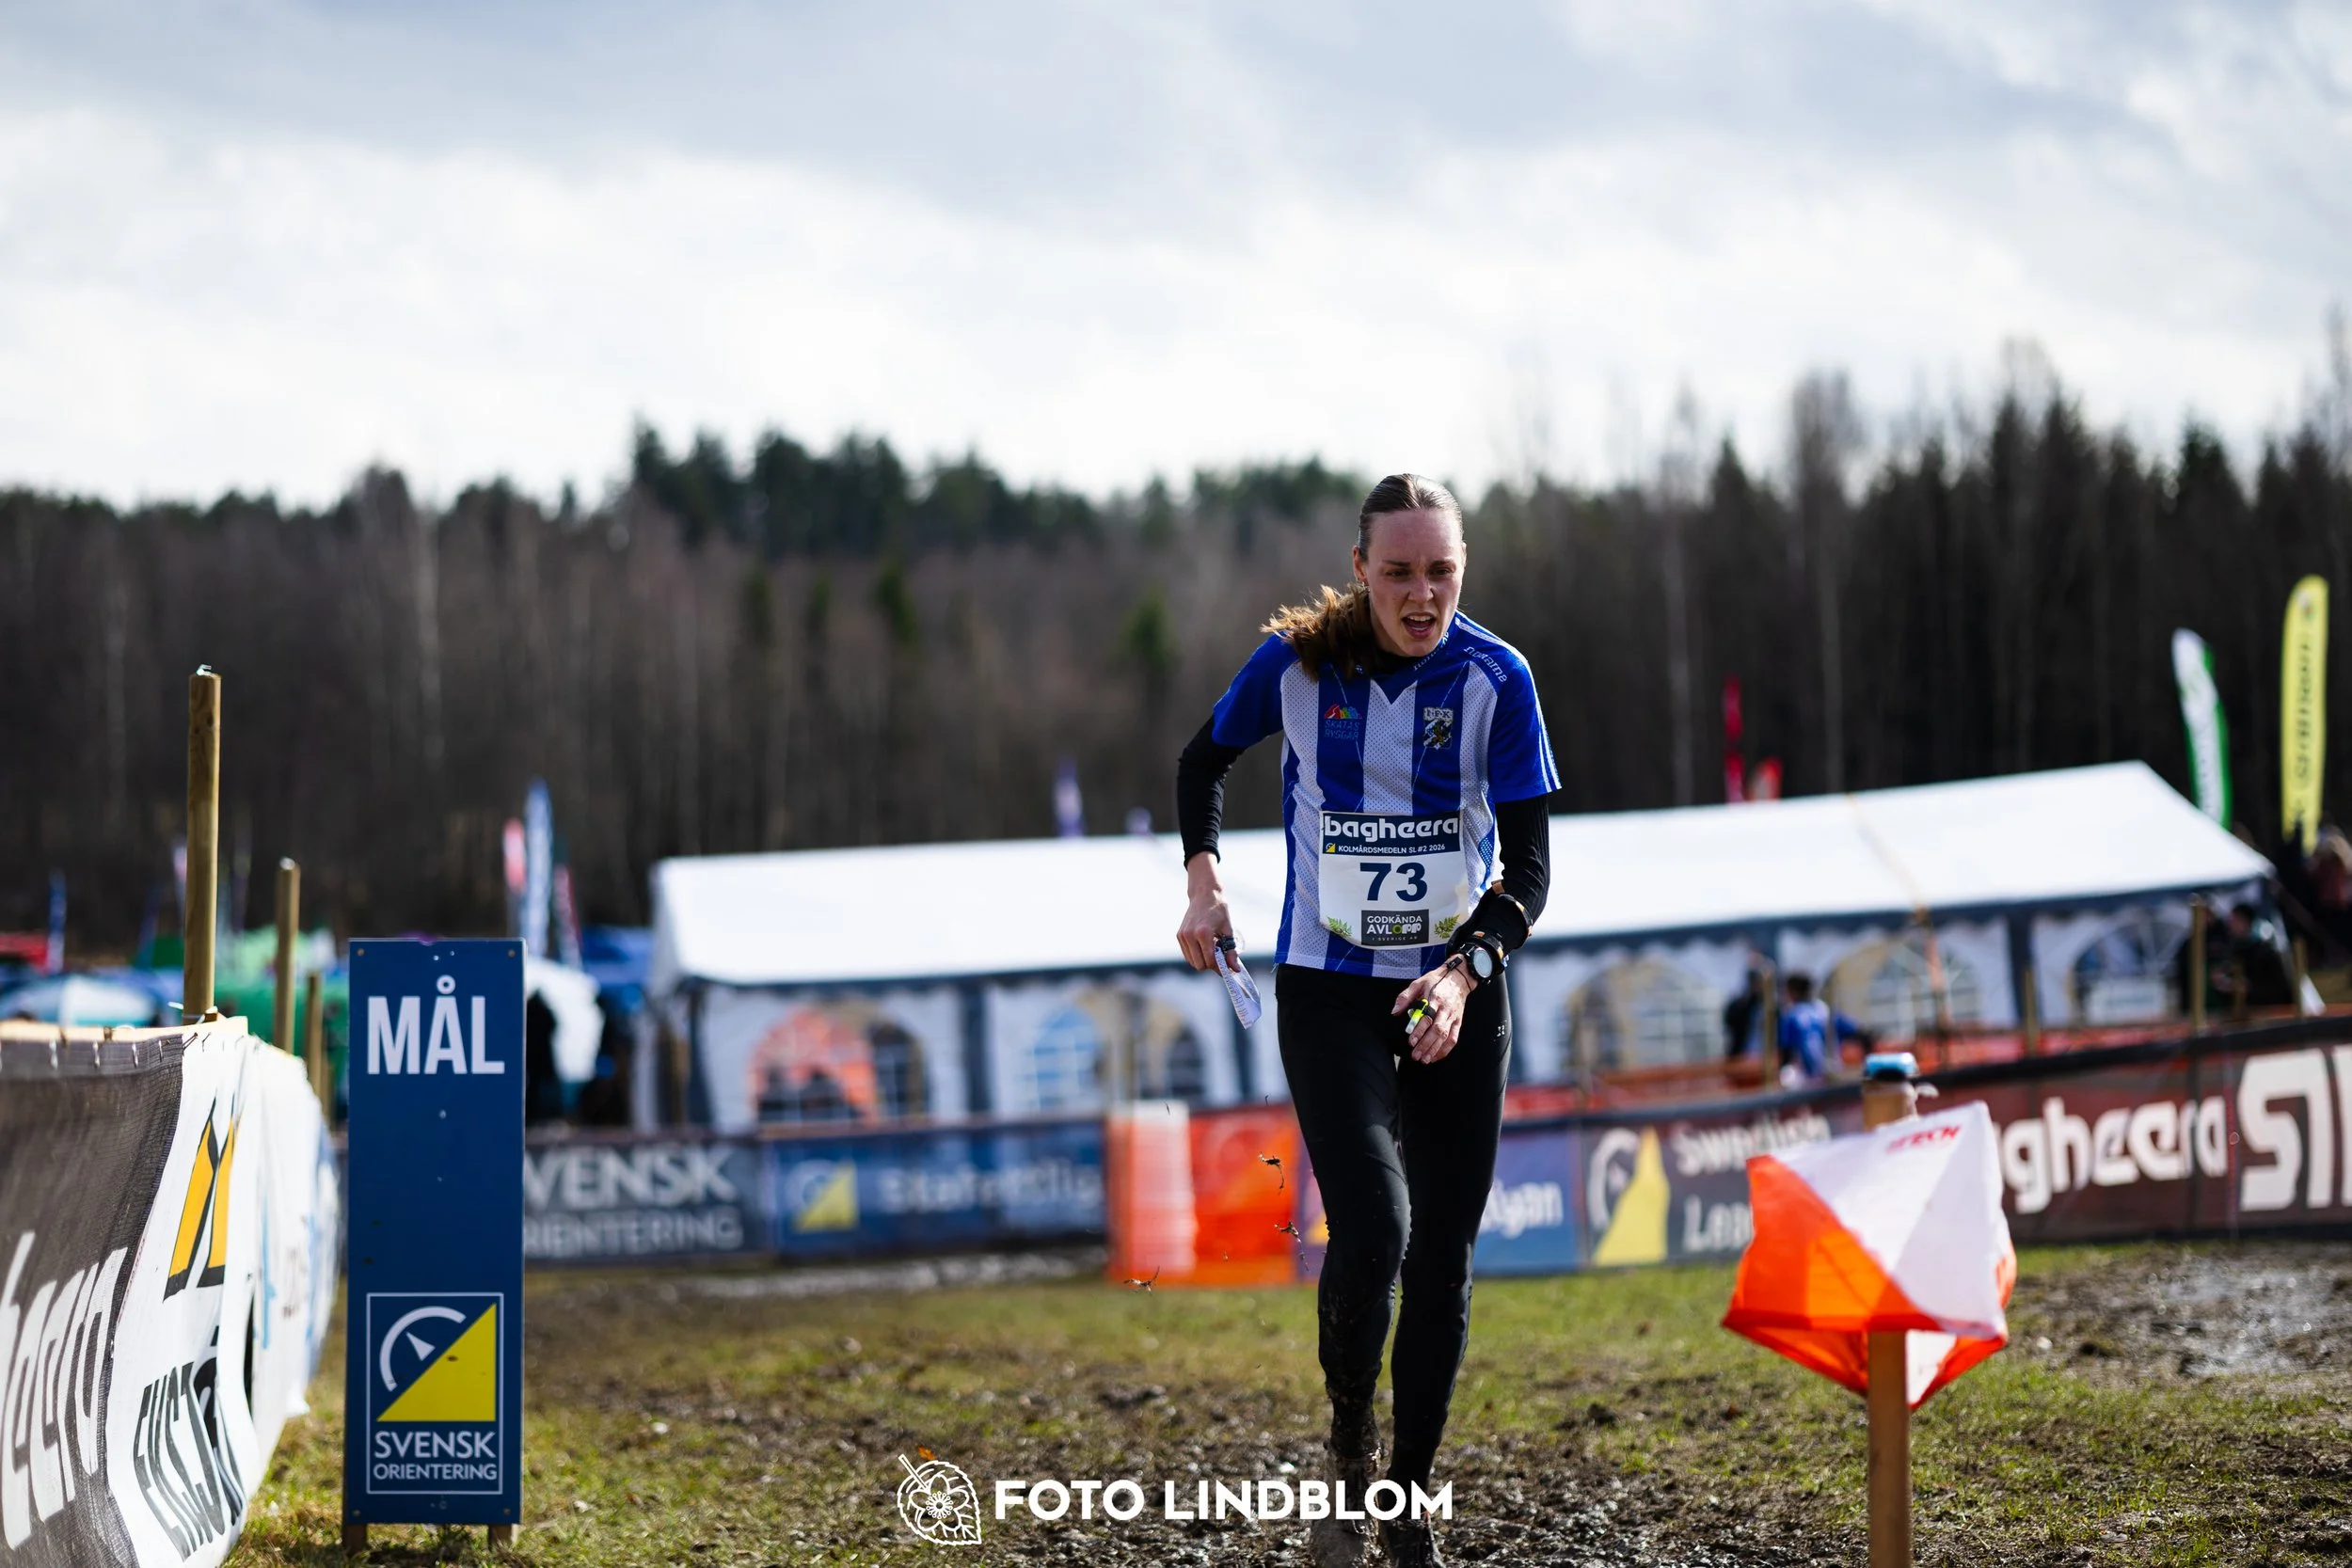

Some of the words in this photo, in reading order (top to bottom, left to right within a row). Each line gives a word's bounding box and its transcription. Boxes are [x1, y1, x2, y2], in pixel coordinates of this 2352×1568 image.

[1324, 816, 1458, 843] bagheera
[1338, 844, 1407, 854] KOLMÅRDSMEDELN
[1417, 845, 1428, 853] #2
[1429, 844, 1446, 852] 2026
[1359, 862, 1428, 902] 73
[1367, 914, 1422, 924] GODKÄNDA
[368, 974, 505, 1075] MÅL
[1996, 1095, 2227, 1215] gheera
[524, 1143, 737, 1210] VENSK
[524, 1208, 743, 1257] RIENTERING
[373, 1430, 497, 1459] SVENSK
[373, 1463, 498, 1481] ORIENTERING
